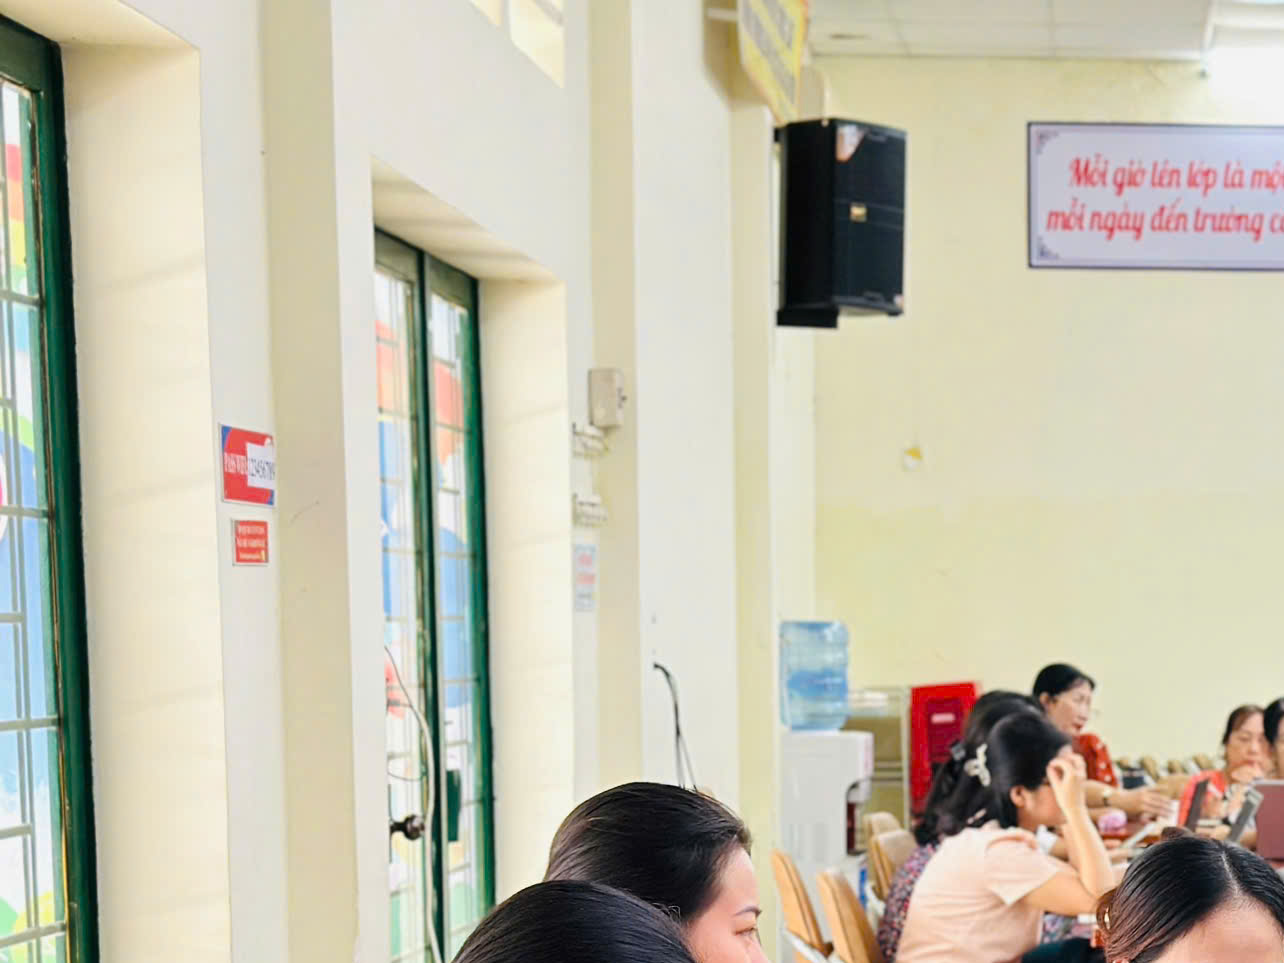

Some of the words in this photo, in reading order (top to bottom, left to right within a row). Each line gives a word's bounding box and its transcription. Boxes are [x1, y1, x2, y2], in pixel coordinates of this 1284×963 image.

[1069, 153, 1107, 188] Mỗi
[1151, 159, 1180, 189] lên
[1223, 161, 1245, 190] là
[1089, 201, 1145, 241] ngày
[1151, 197, 1187, 232] đến
[1193, 204, 1264, 243] trường
